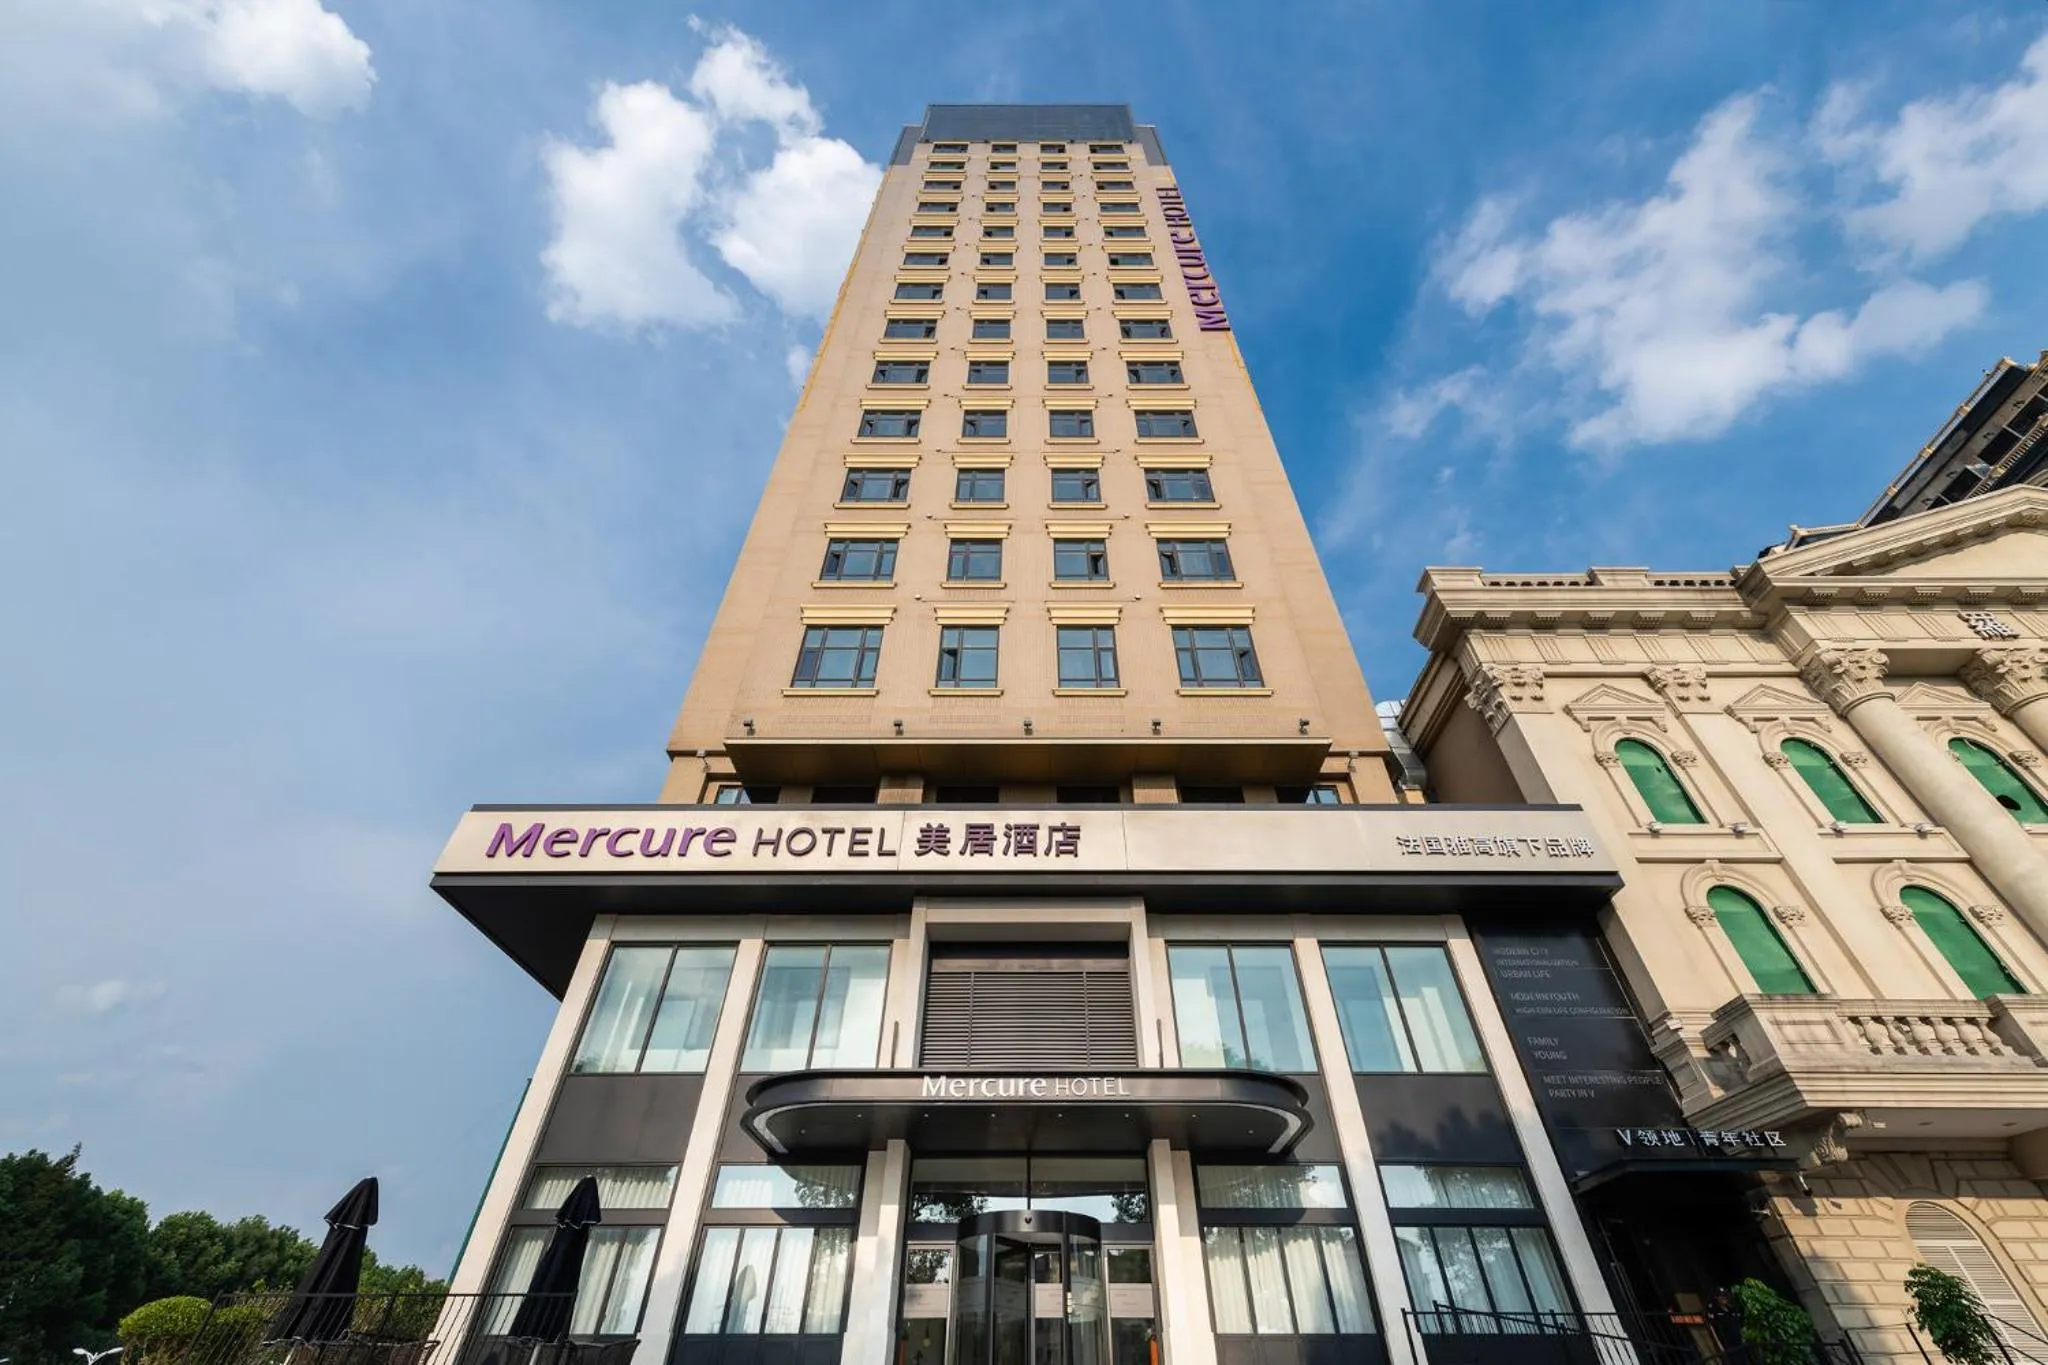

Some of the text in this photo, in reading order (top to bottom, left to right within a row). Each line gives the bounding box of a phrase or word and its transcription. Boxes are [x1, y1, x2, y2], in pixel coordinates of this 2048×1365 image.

[485, 822, 1081, 858] Mercure HOTEL 美居酒店
[1396, 834, 1594, 858] 法国雅高旗下品牌
[1527, 1036, 1559, 1046] FAMILY
[1533, 1051, 1567, 1060] YOUNG
[1543, 1075, 1567, 1084] MEET
[921, 1075, 1131, 1097] Mercure HOTEL
[1549, 1089, 1576, 1097] PARTY
